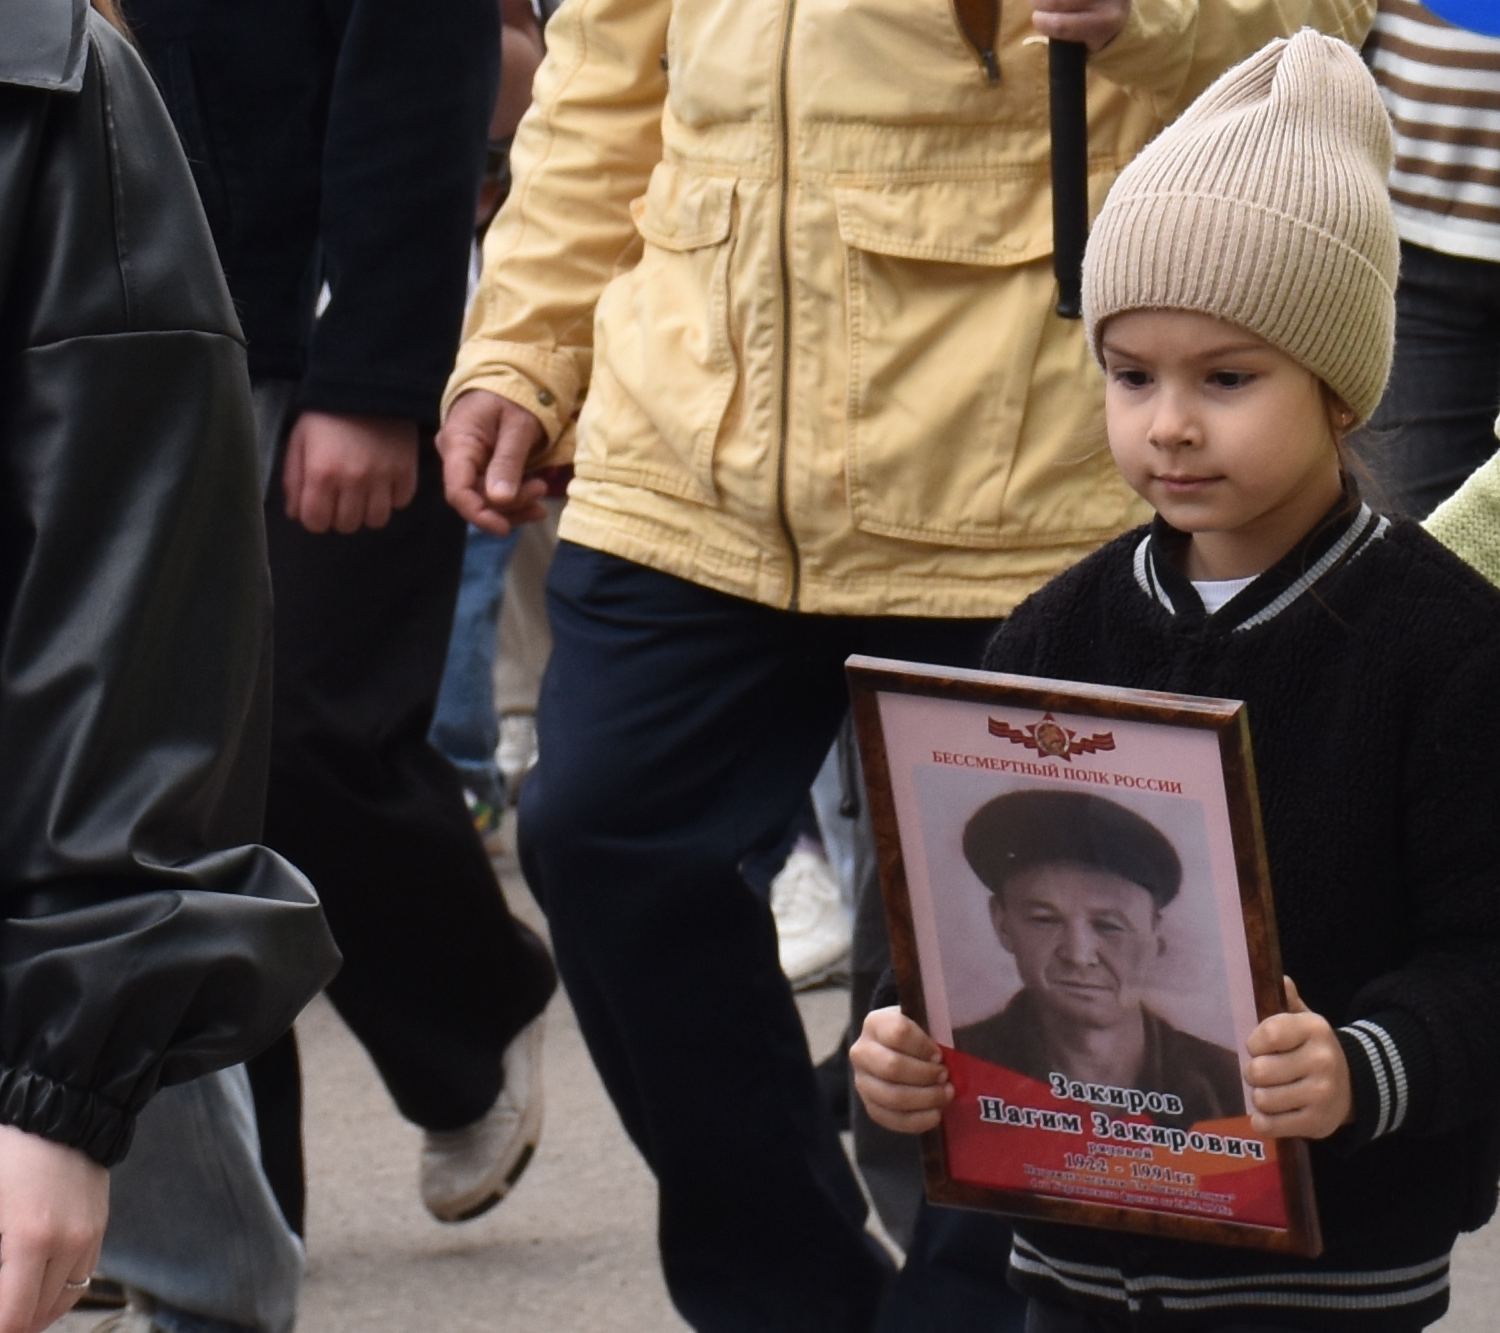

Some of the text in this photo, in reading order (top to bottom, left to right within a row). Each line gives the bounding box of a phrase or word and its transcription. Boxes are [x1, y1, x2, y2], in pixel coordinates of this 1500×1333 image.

[932, 750, 1183, 795] БЕССМЕРТНЫЙ ПОЛК РОССИИ
[1050, 1073, 1183, 1114] Закиров
[979, 1097, 1265, 1160] Нагим Закирович
[1064, 1154, 1108, 1173] 1922
